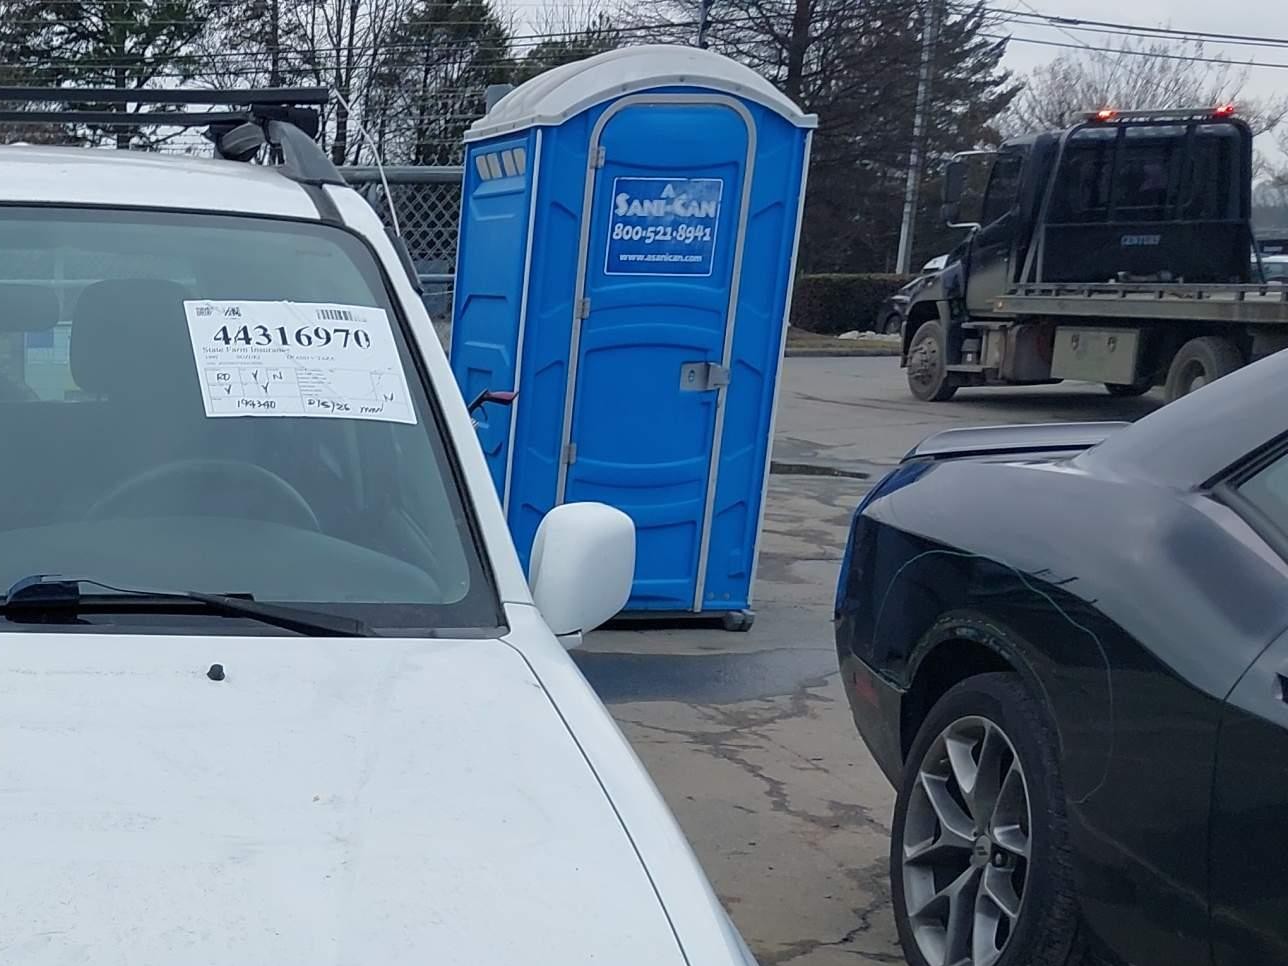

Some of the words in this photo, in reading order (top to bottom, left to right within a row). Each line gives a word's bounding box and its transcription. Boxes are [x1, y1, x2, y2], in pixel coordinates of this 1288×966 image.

[614, 192, 717, 218] SANI-CAN
[619, 252, 702, 263] www.asanican.com
[213, 325, 371, 350] 44316970
